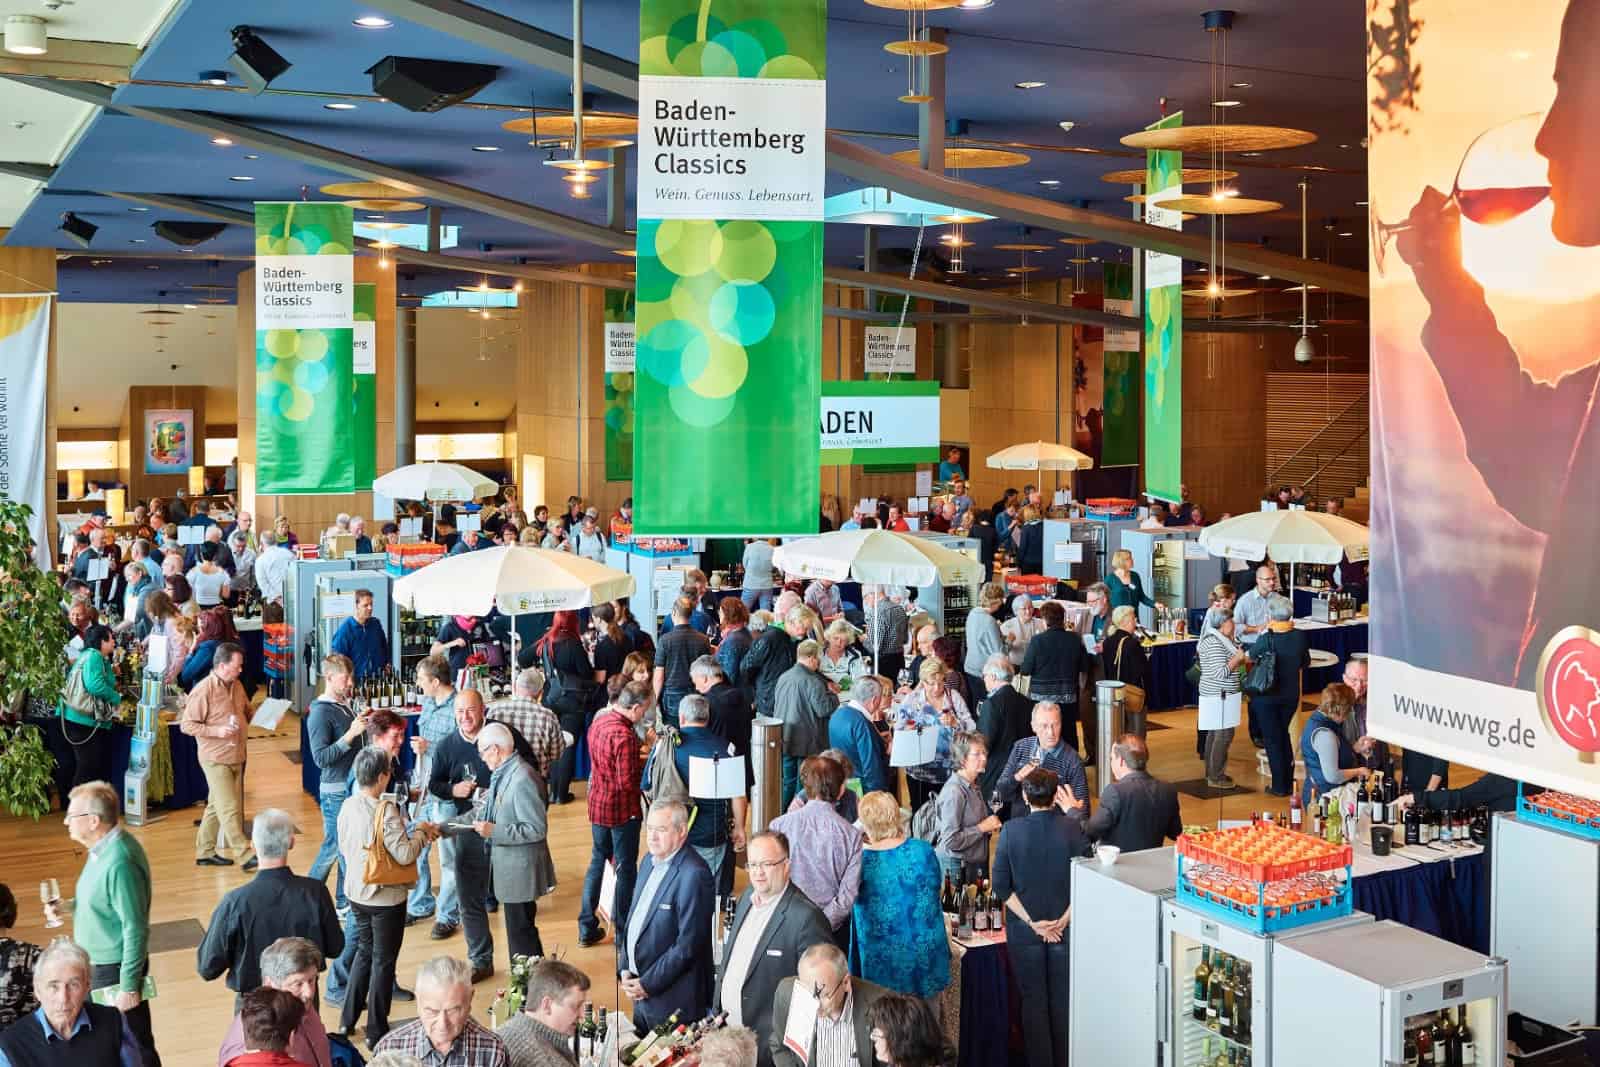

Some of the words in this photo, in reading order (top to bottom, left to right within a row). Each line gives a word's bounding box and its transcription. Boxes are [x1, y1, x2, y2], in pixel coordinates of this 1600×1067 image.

[655, 99, 736, 121] Baden-
[654, 126, 806, 154] Württemberg
[654, 153, 747, 175] Classics
[655, 188, 690, 201] Wein.
[695, 189, 744, 201] Genuss.
[263, 267, 309, 279] Baden-
[263, 281, 343, 294] Württemberg
[263, 295, 312, 306] Classics
[820, 411, 873, 434] DEN
[1393, 693, 1536, 748] www.wwg.de
